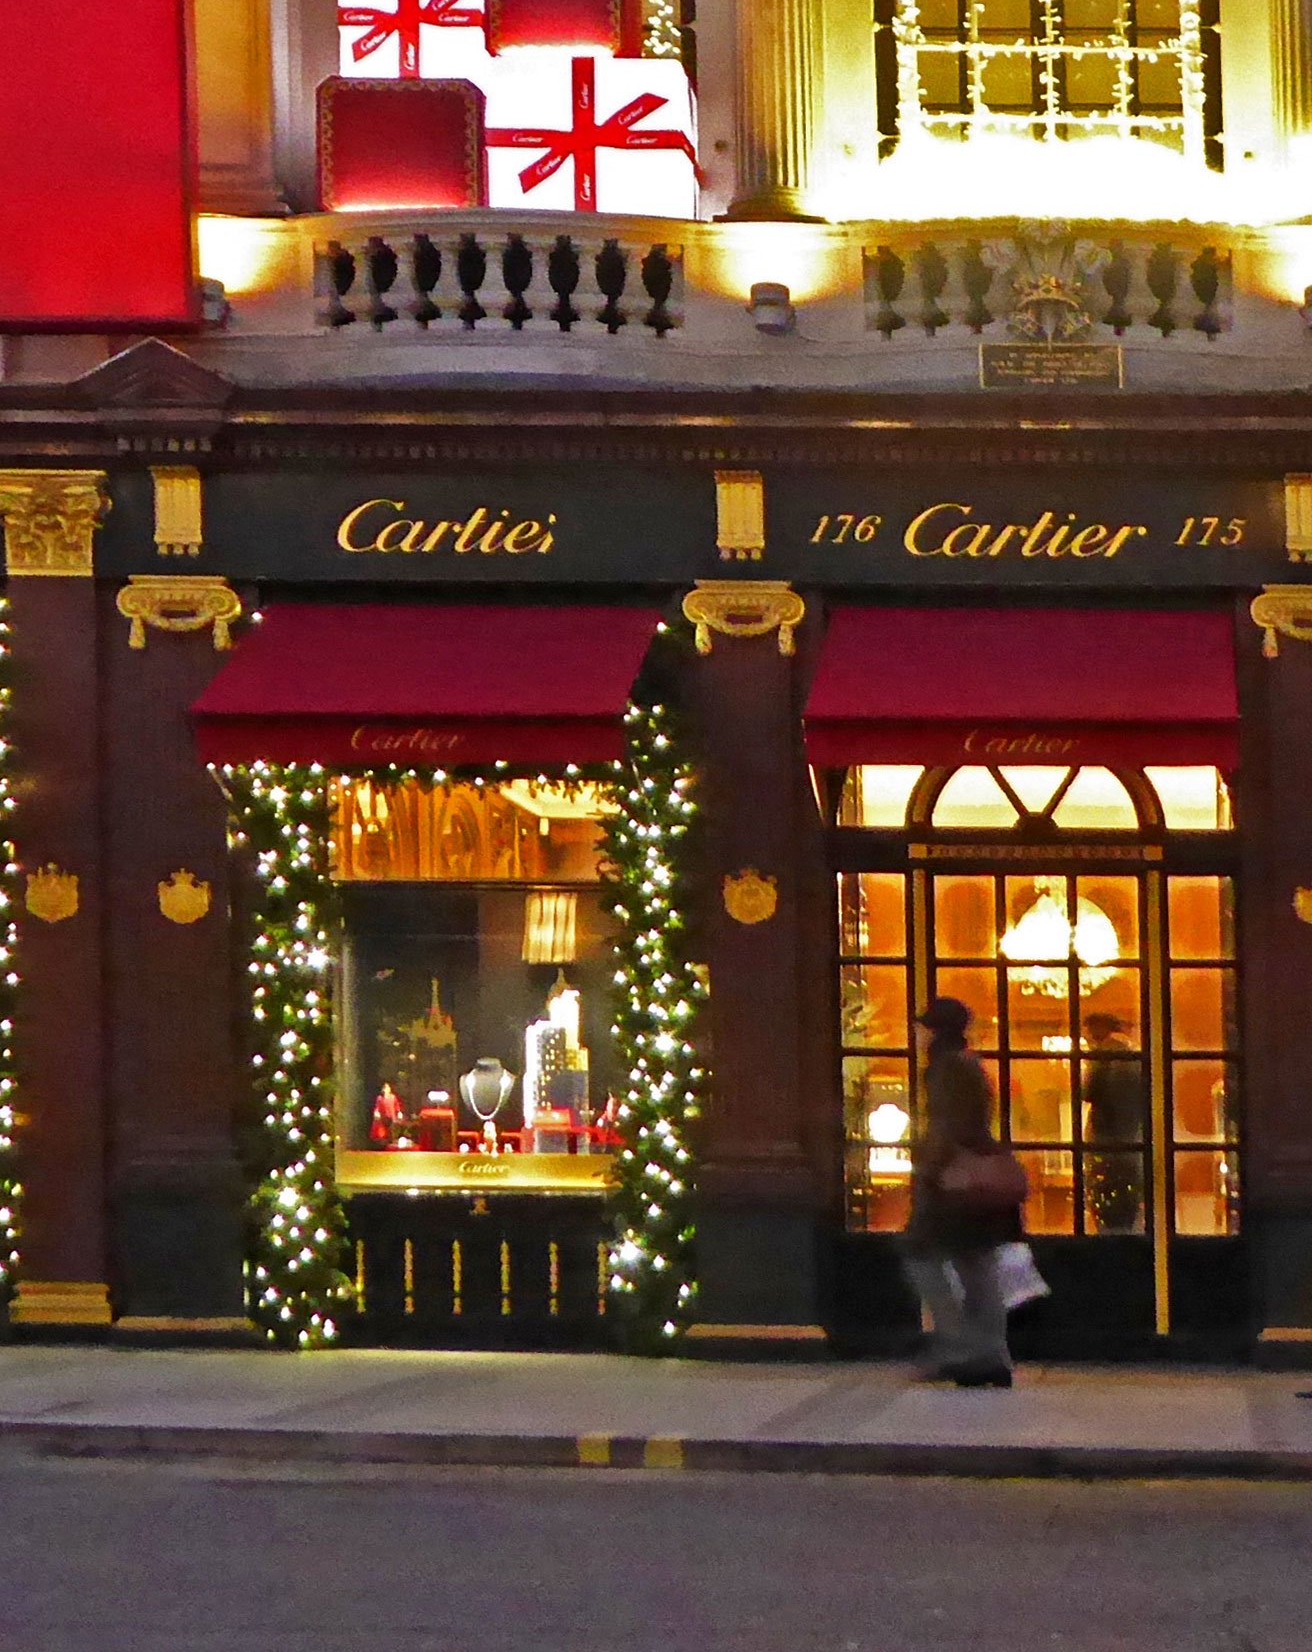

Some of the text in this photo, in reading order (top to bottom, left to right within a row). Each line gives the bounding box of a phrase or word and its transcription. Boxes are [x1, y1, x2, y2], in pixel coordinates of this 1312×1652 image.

[810, 502, 1246, 559] 176 Cartier 175
[350, 725, 465, 750] Cartier
[964, 729, 1080, 753] Cartier
